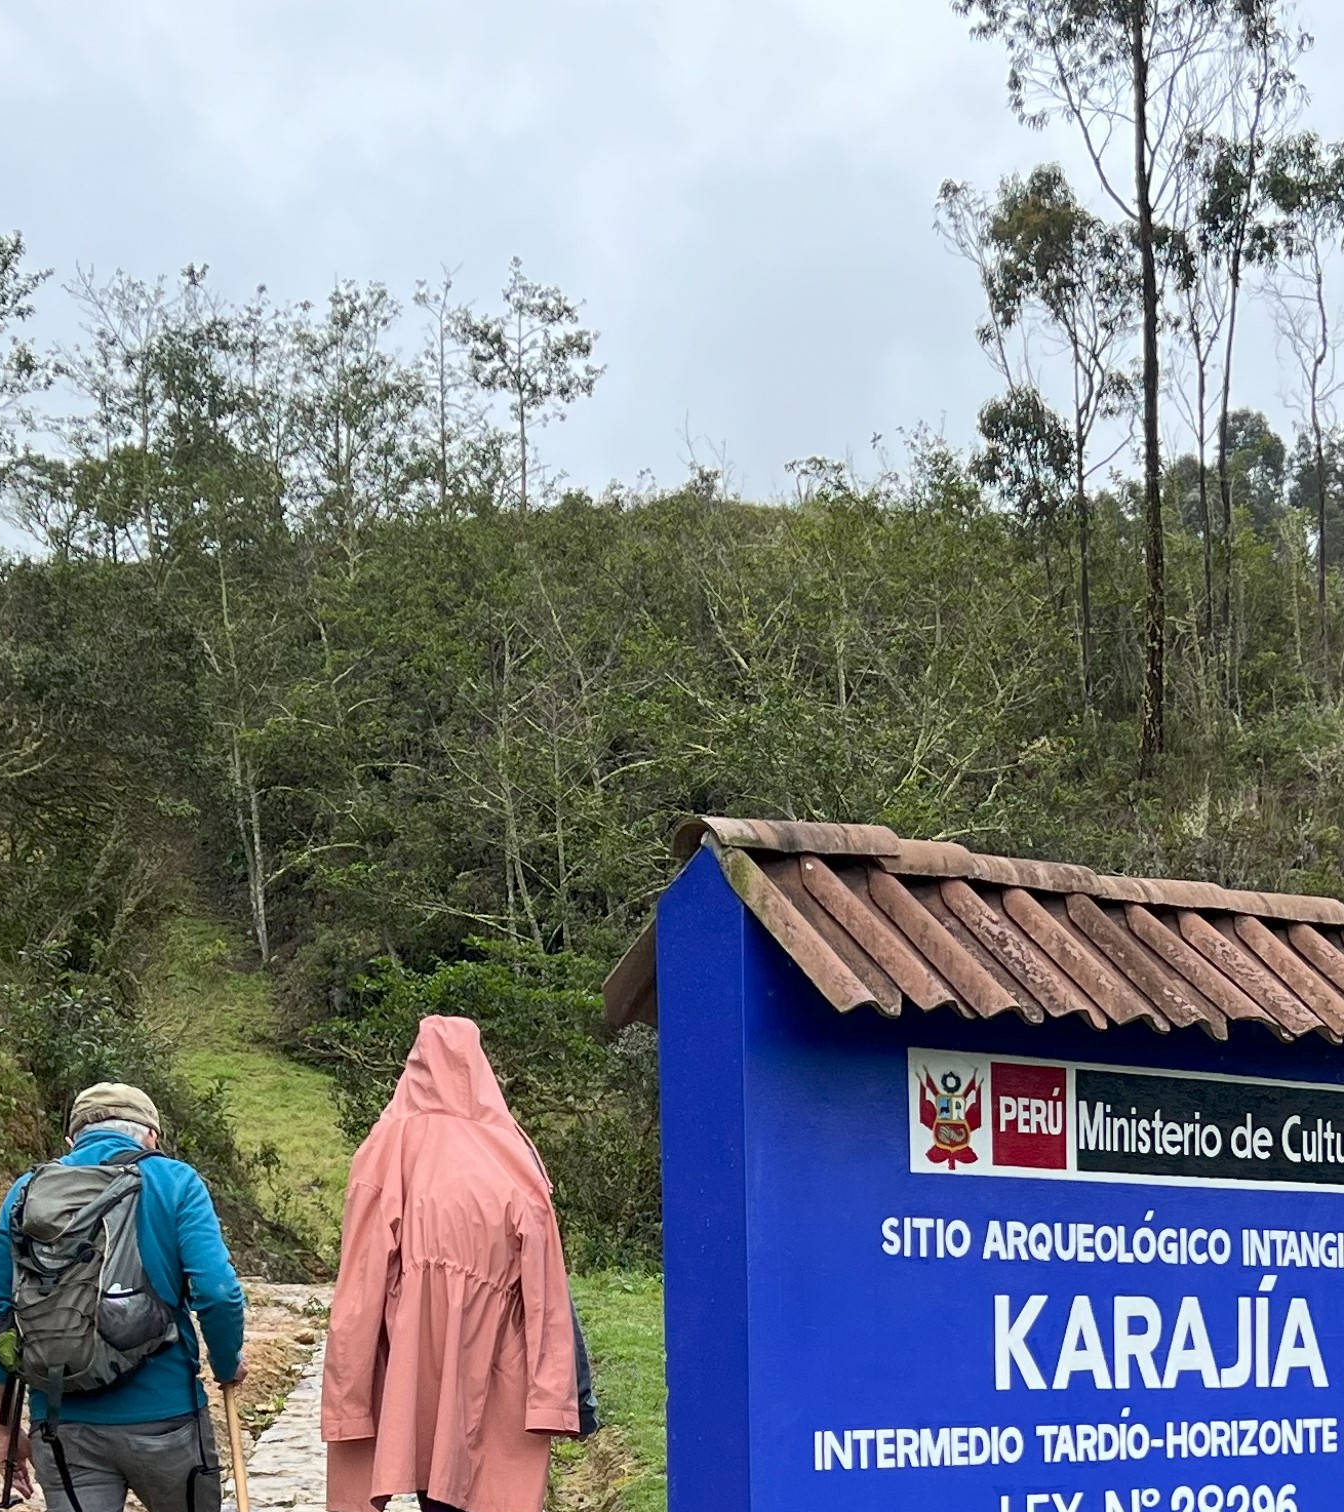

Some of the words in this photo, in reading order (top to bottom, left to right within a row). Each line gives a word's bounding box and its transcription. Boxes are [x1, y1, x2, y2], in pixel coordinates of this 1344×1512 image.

[998, 1086, 1063, 1135] PERÚ
[1077, 1099, 1223, 1158] Ministerio
[1229, 1112, 1274, 1160] de
[881, 1217, 971, 1258] SITIO
[982, 1210, 1231, 1266] ARQUEOLÓGICO
[993, 1274, 1330, 1392] KARAJÍA
[813, 1426, 1024, 1471] INTERMEDIO
